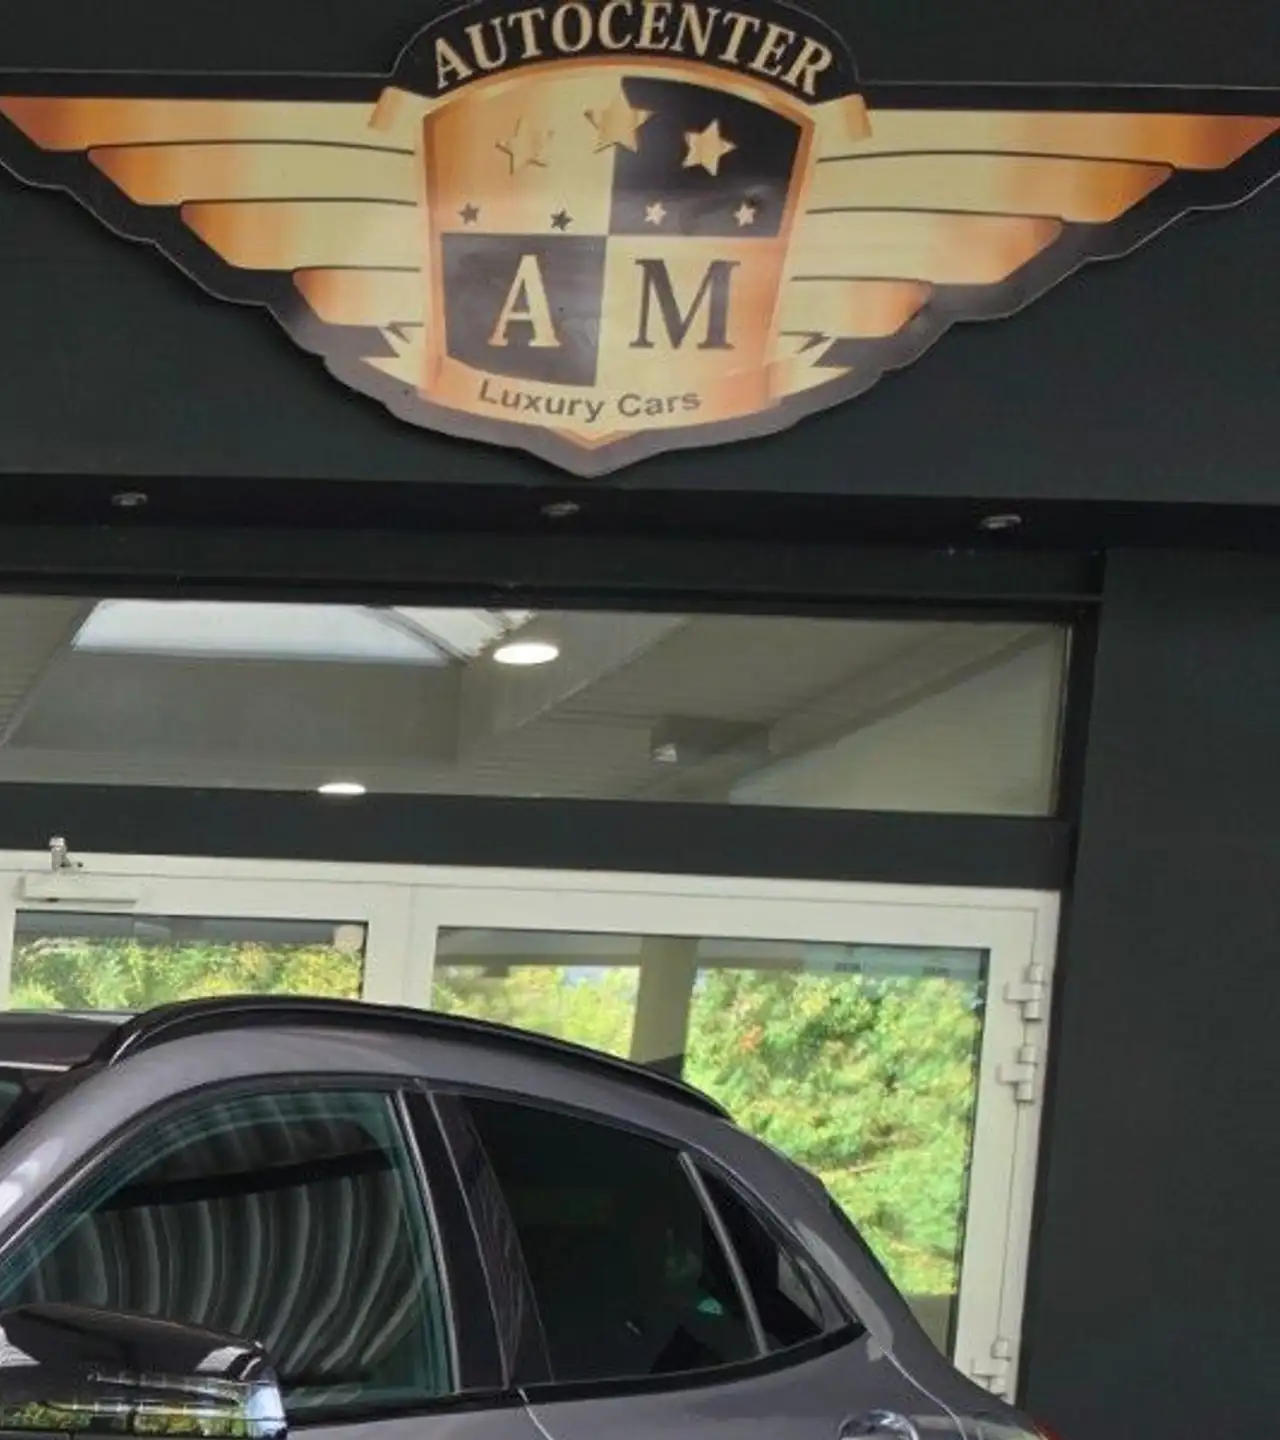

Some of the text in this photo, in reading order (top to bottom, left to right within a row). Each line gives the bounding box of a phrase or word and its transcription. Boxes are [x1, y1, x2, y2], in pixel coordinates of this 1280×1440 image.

[433, 1, 834, 96] AUTOCENTER
[487, 253, 742, 351] A M
[478, 379, 702, 424] Luxury Cars
